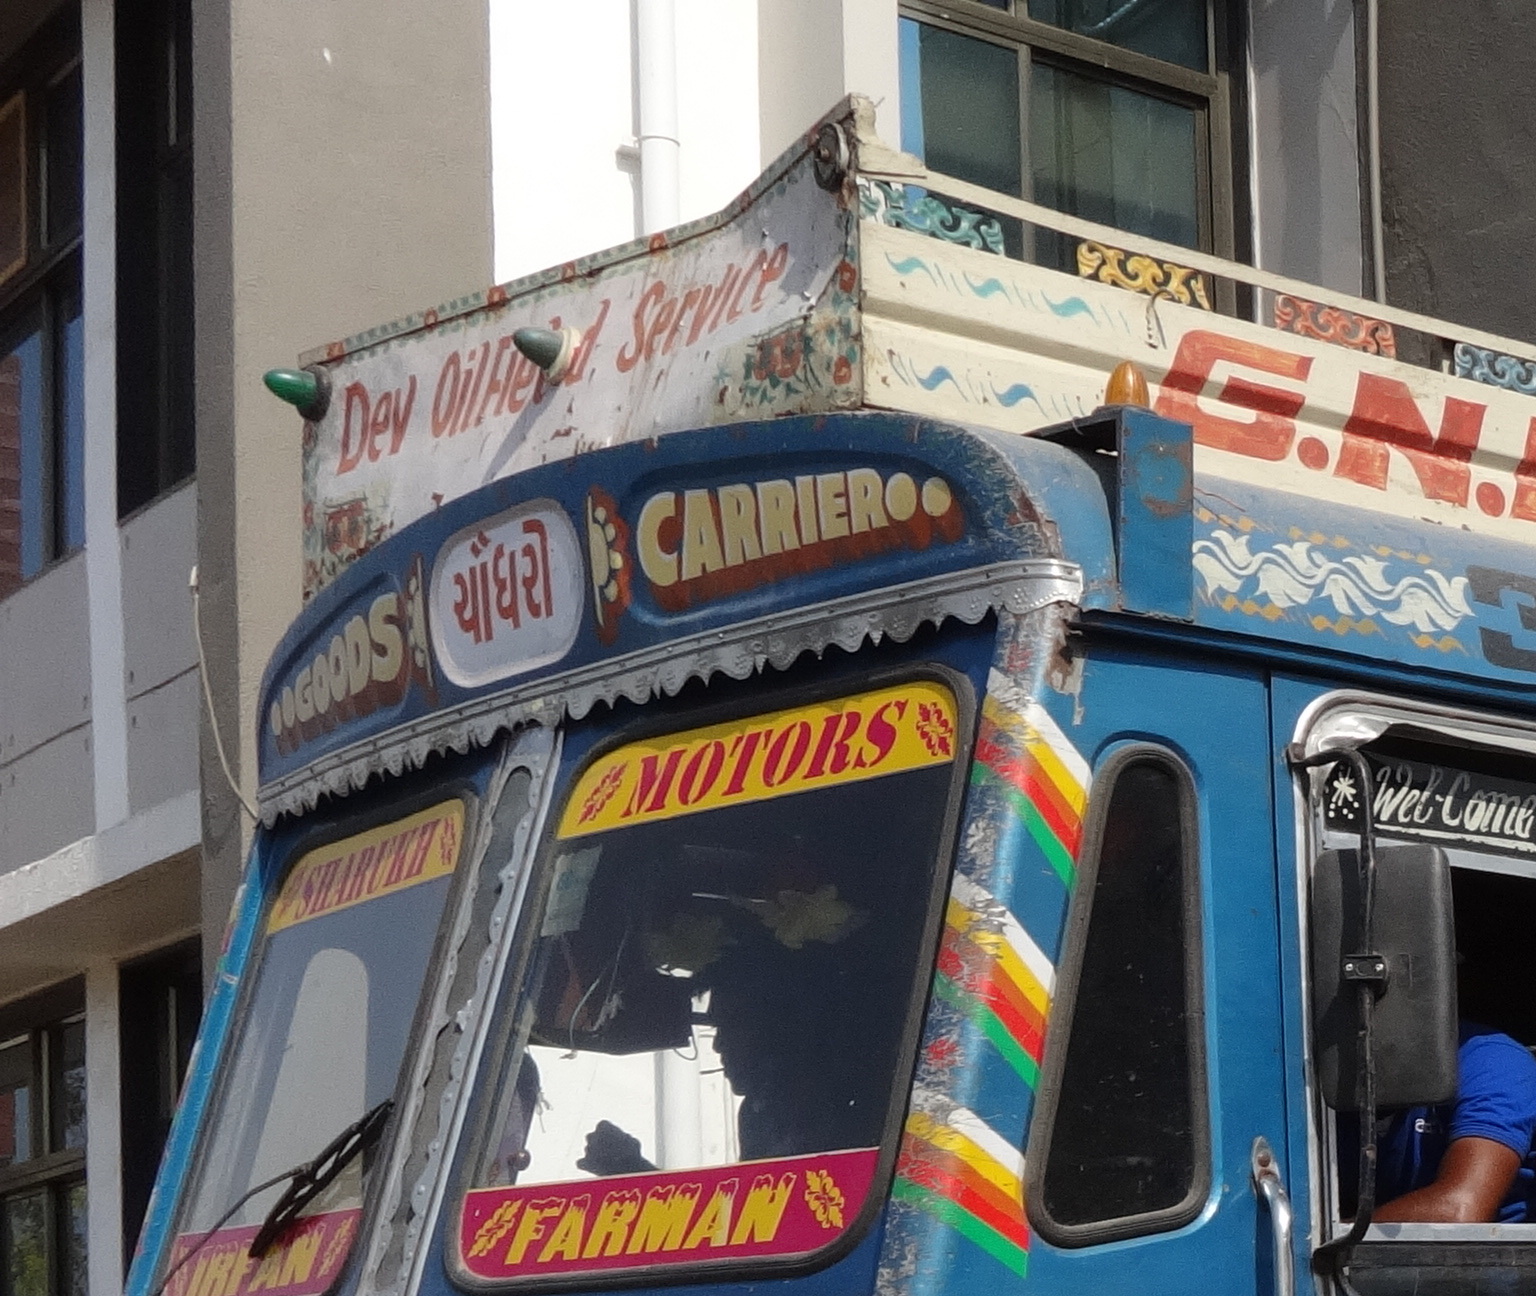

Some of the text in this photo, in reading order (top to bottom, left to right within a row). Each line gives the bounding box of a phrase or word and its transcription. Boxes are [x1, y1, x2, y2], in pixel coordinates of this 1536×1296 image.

[336, 242, 788, 475] Dev OilFied Service
[621, 698, 910, 820] MOTORS
[504, 1172, 797, 1265] FARMAN
